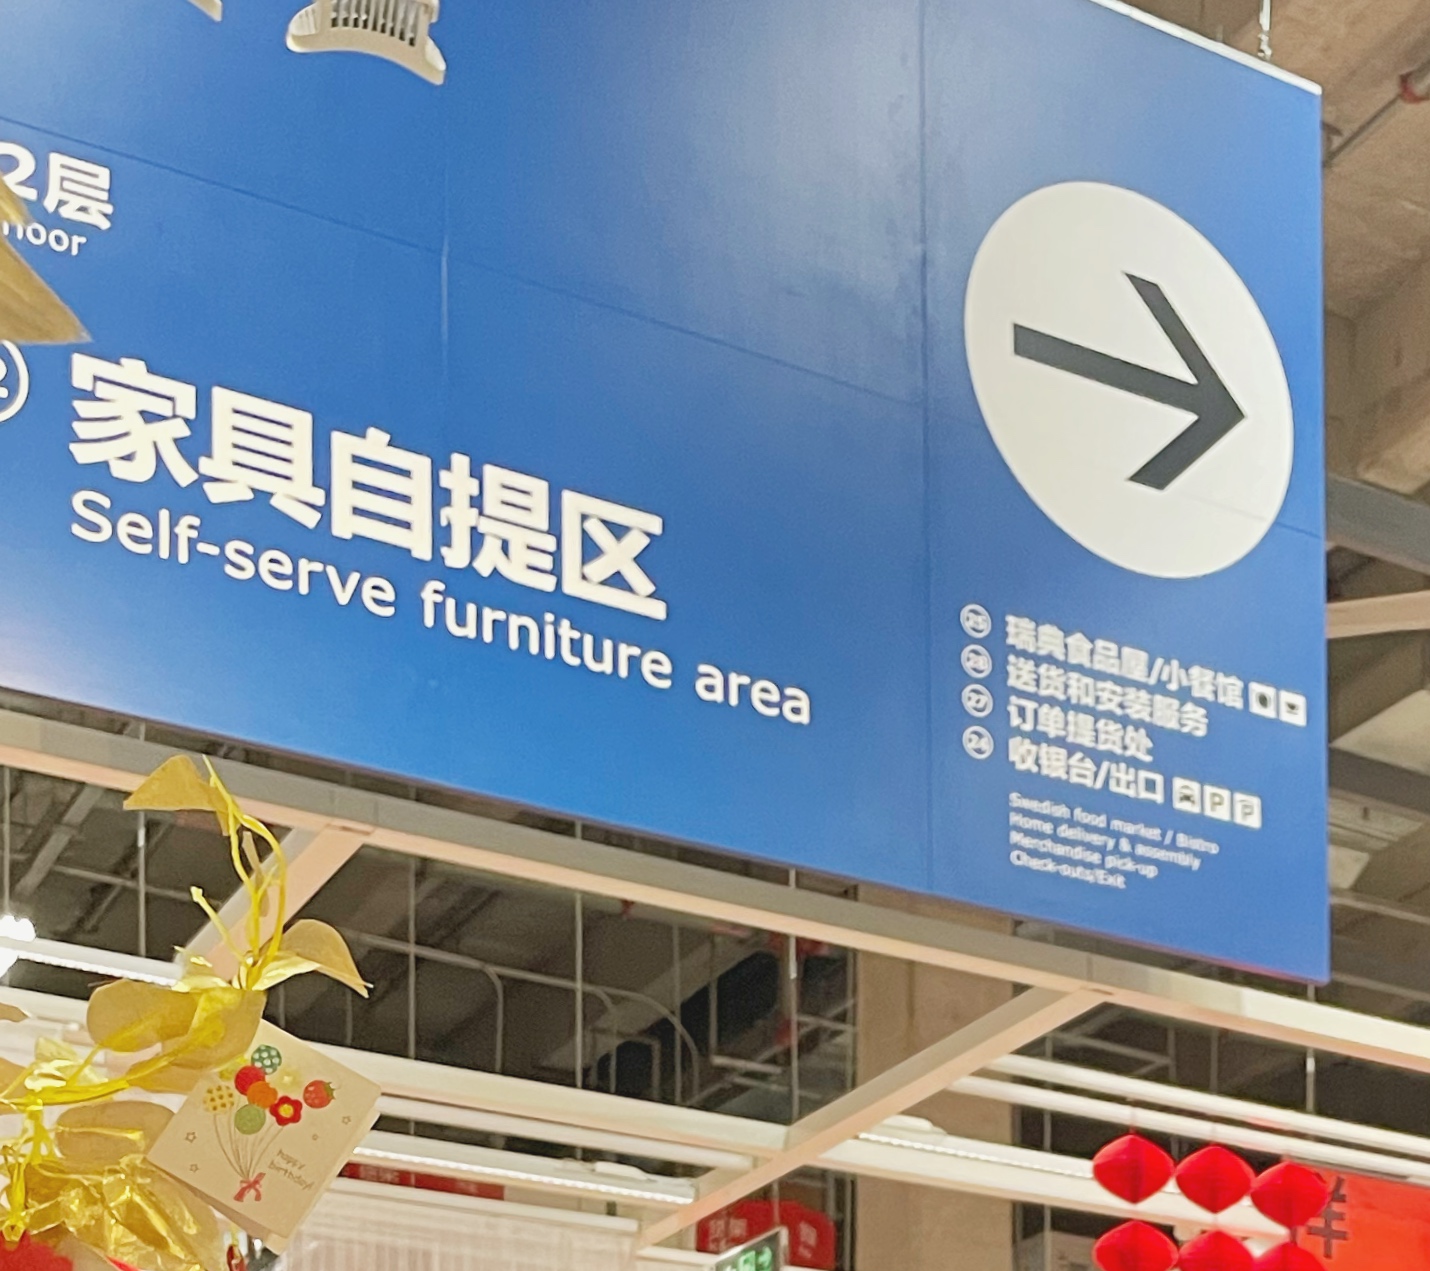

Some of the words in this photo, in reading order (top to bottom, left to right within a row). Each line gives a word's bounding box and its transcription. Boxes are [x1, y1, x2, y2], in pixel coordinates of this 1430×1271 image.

[69, 352, 667, 621] 家具自提区
[71, 489, 396, 618] Self-serve
[420, 579, 673, 689] furniture
[695, 663, 812, 726] area
[1006, 653, 1209, 738] 送货和安装服务
[1007, 695, 1153, 763] 订单提货处
[1008, 736, 1165, 804] 收银台/出口
[1008, 792, 1071, 819] Swedish
[1073, 807, 1107, 828] food
[1110, 819, 1162, 841] market
[1009, 811, 1054, 834] Home
[1056, 823, 1116, 852] delivery
[1134, 843, 1201, 871] assembly
[1009, 830, 1102, 864] Merchandise
